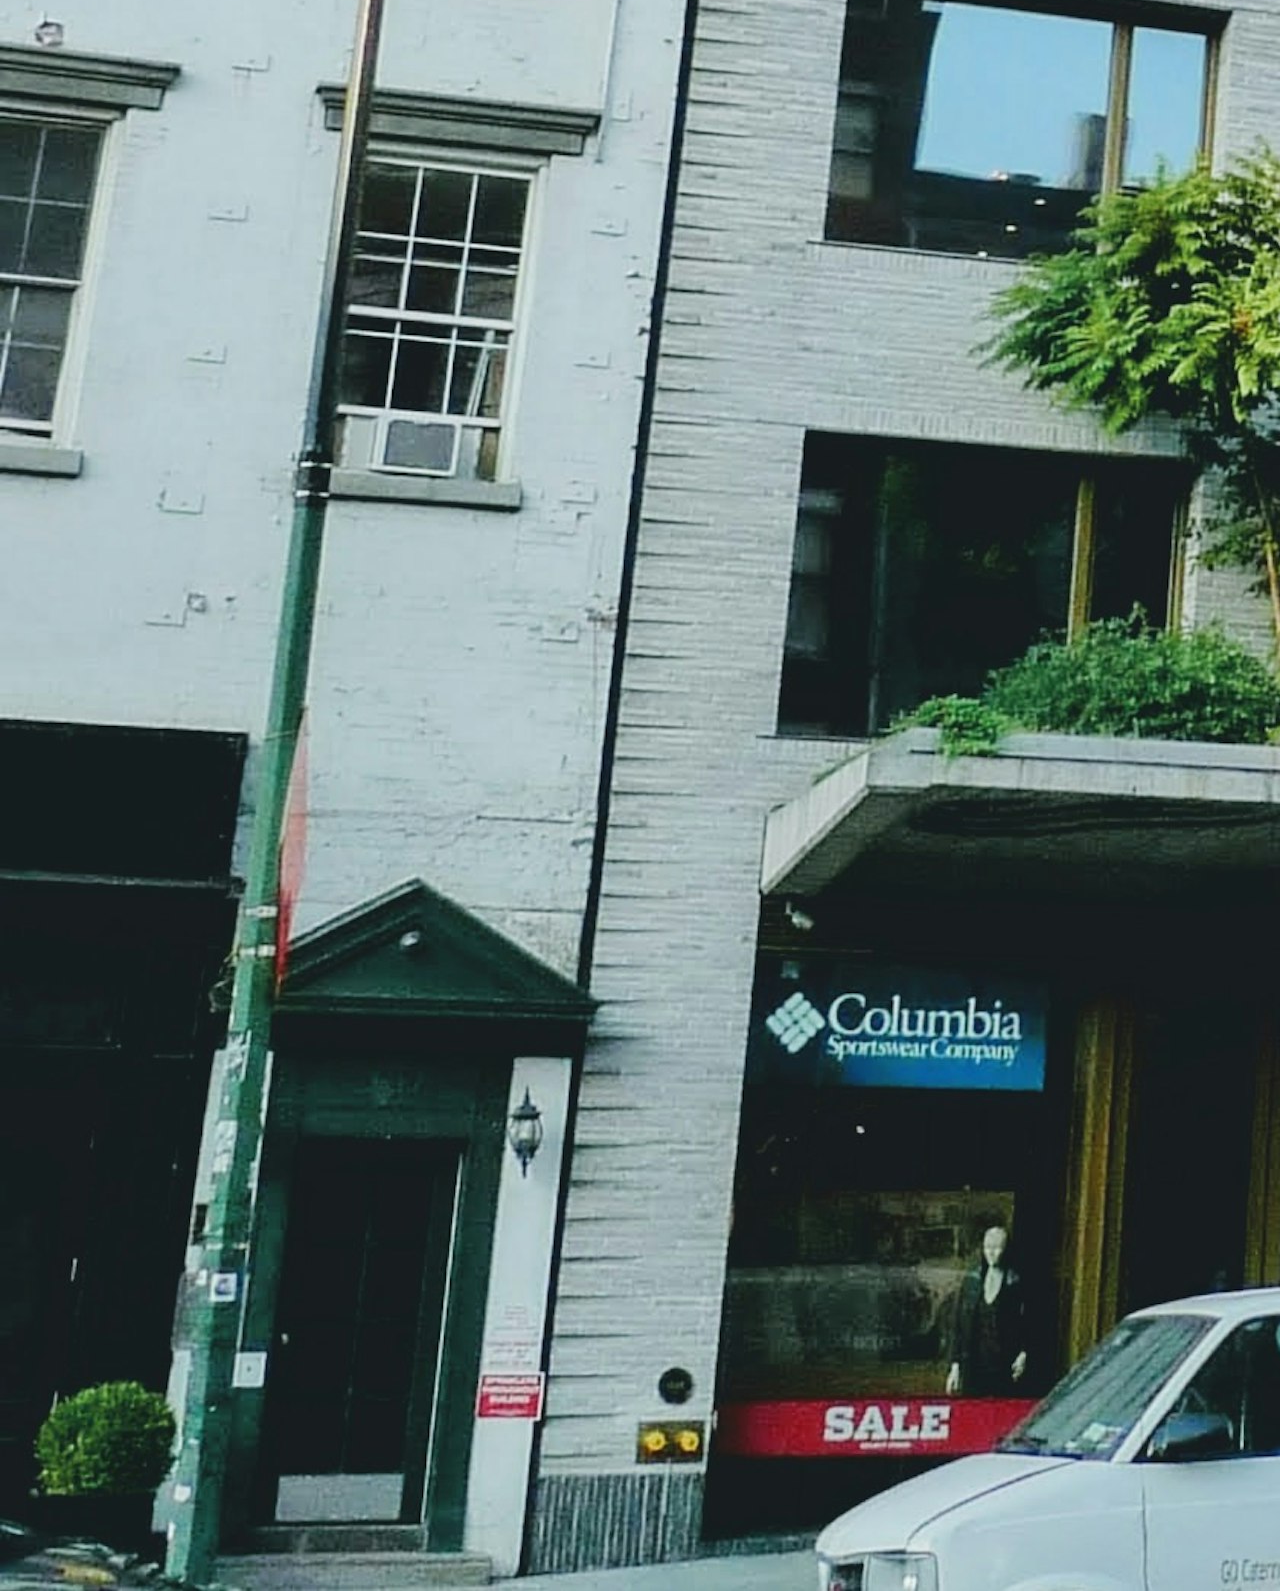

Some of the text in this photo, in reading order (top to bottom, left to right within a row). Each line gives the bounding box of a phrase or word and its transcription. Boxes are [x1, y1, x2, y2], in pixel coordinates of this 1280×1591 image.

[827, 993, 1022, 1040] Columbia
[827, 1034, 1019, 1066] Sportswear Company
[823, 1405, 951, 1442] SALE
